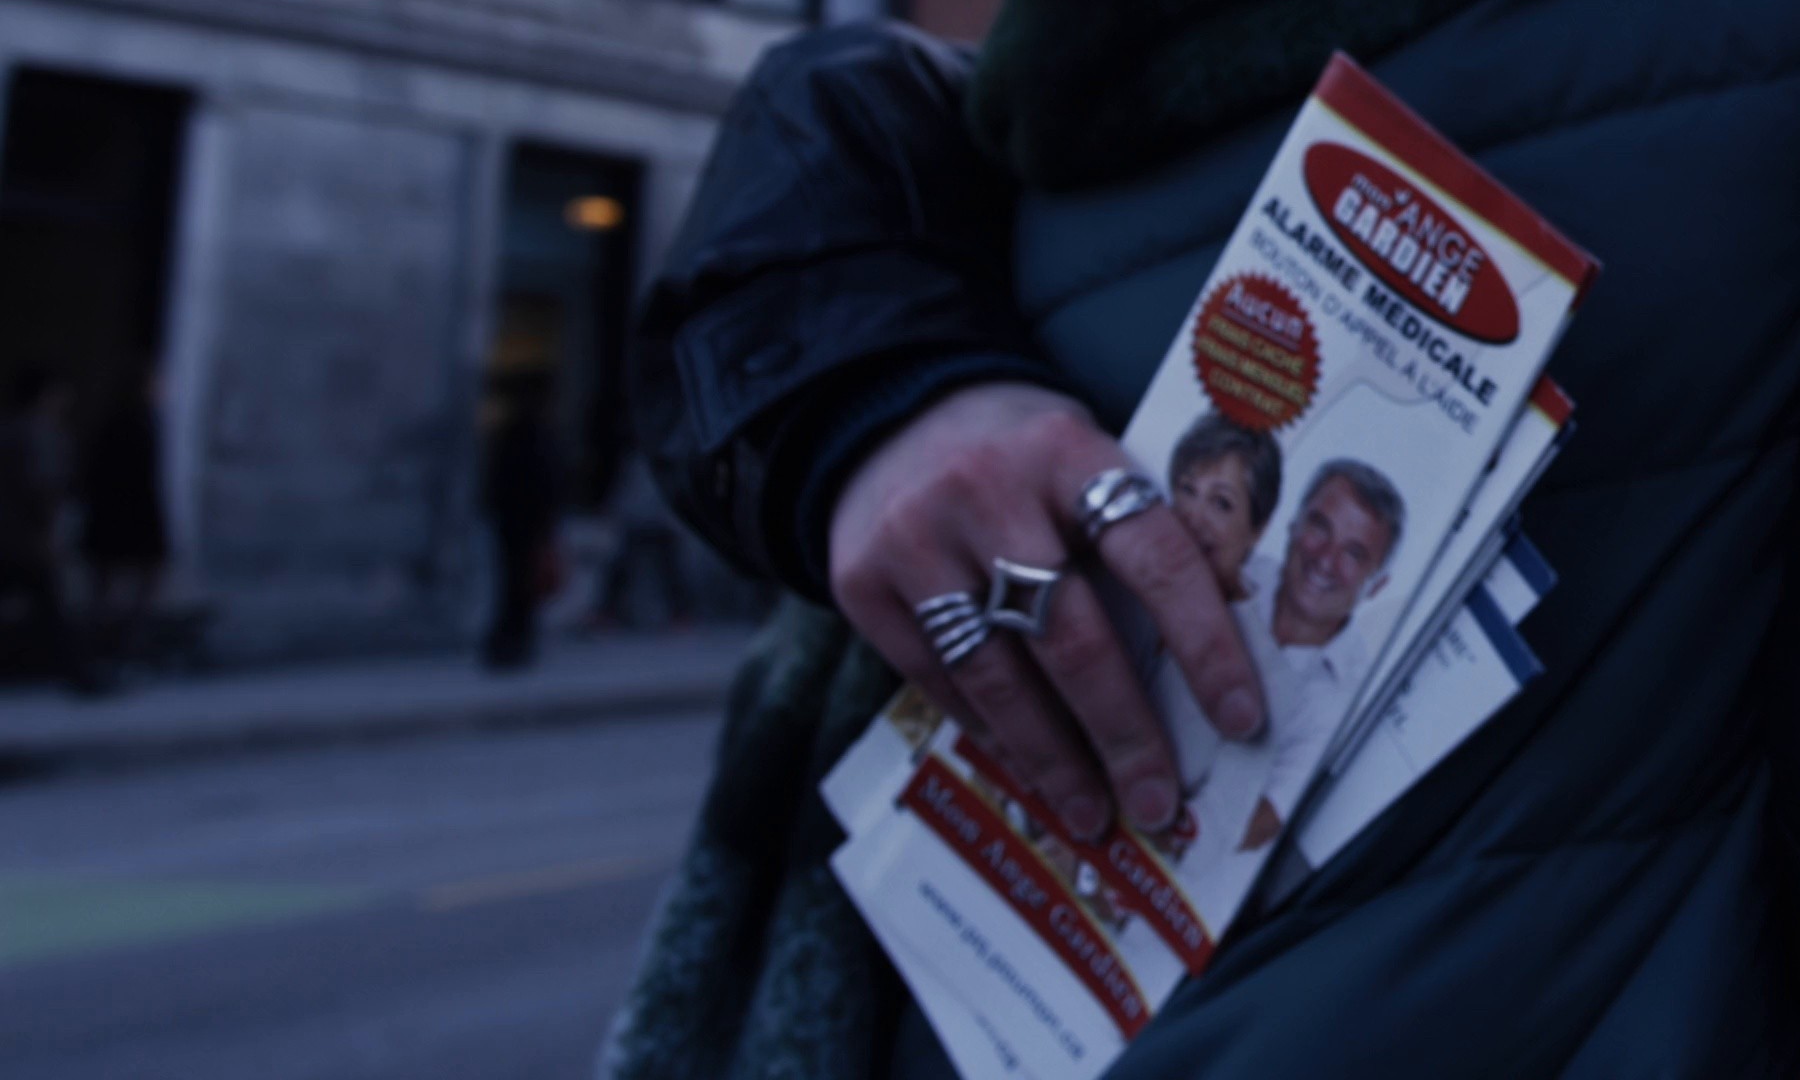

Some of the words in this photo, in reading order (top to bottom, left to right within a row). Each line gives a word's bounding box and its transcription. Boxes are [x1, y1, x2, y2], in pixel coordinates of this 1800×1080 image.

[1250, 227, 1322, 301] BOUTON
[1262, 198, 1361, 294] ALARME
[1332, 185, 1475, 317] GARDIEN
[1351, 172, 1394, 213] mon
[1394, 201, 1485, 284] ANGE
[918, 774, 981, 846] Mon
[980, 838, 1048, 911] Ange
[1049, 903, 1144, 1021] Gardien
[1107, 838, 1204, 951] Gardien
